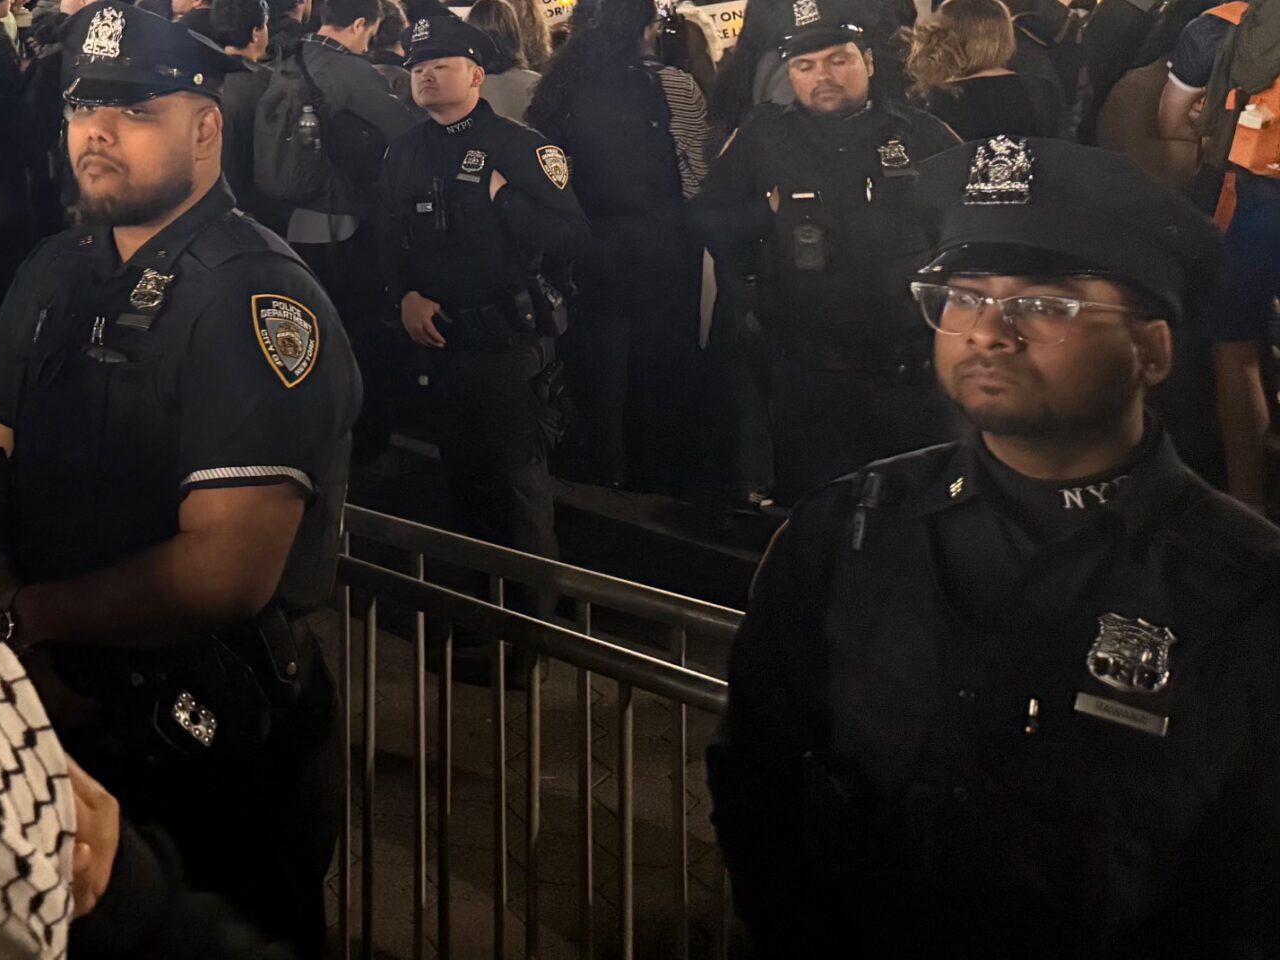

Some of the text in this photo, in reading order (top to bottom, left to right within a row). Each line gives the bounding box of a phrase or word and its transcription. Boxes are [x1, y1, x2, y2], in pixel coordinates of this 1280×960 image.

[261, 309, 312, 334] DEPARTMENT
[272, 300, 302, 317] POLICE
[261, 328, 284, 367] CITY OF
[294, 339, 315, 376] NEW YORK
